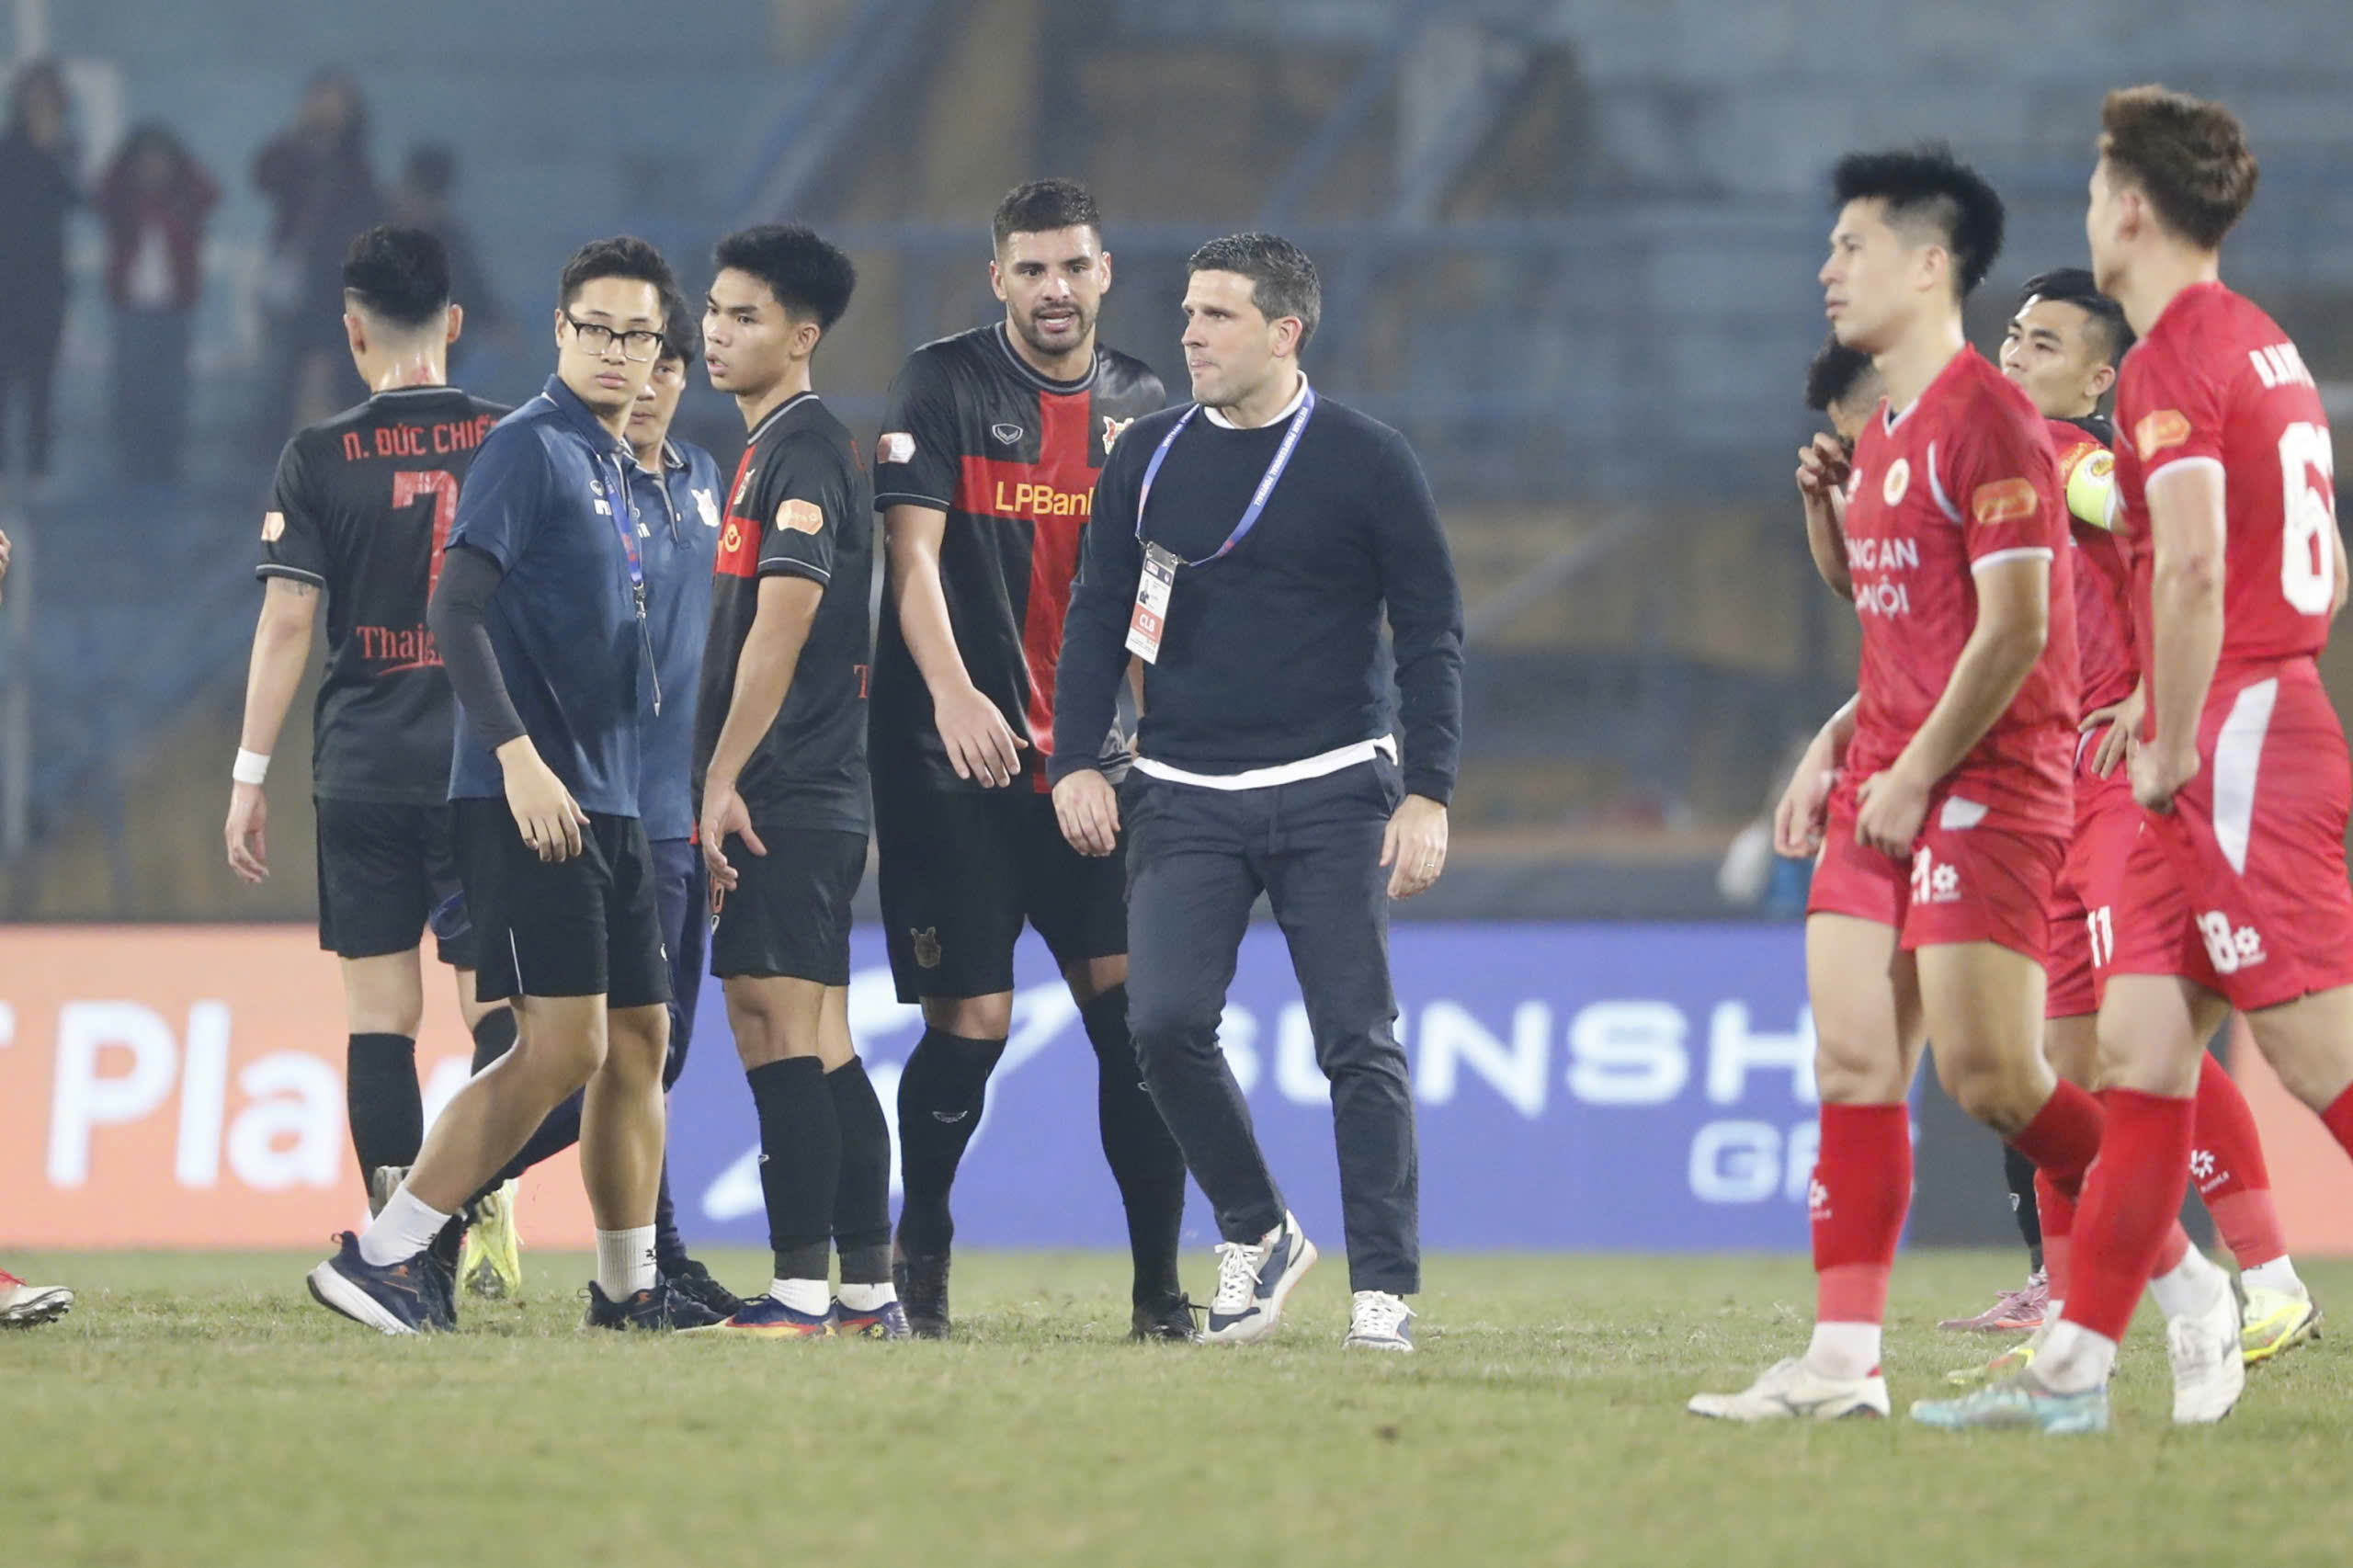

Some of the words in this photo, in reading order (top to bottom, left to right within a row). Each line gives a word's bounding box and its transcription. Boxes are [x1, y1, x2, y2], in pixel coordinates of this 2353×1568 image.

[374, 422, 426, 456] ĐỨC
[392, 470, 459, 603] 7
[1878, 537, 1919, 569] AN
[2278, 421, 2336, 615] 6
